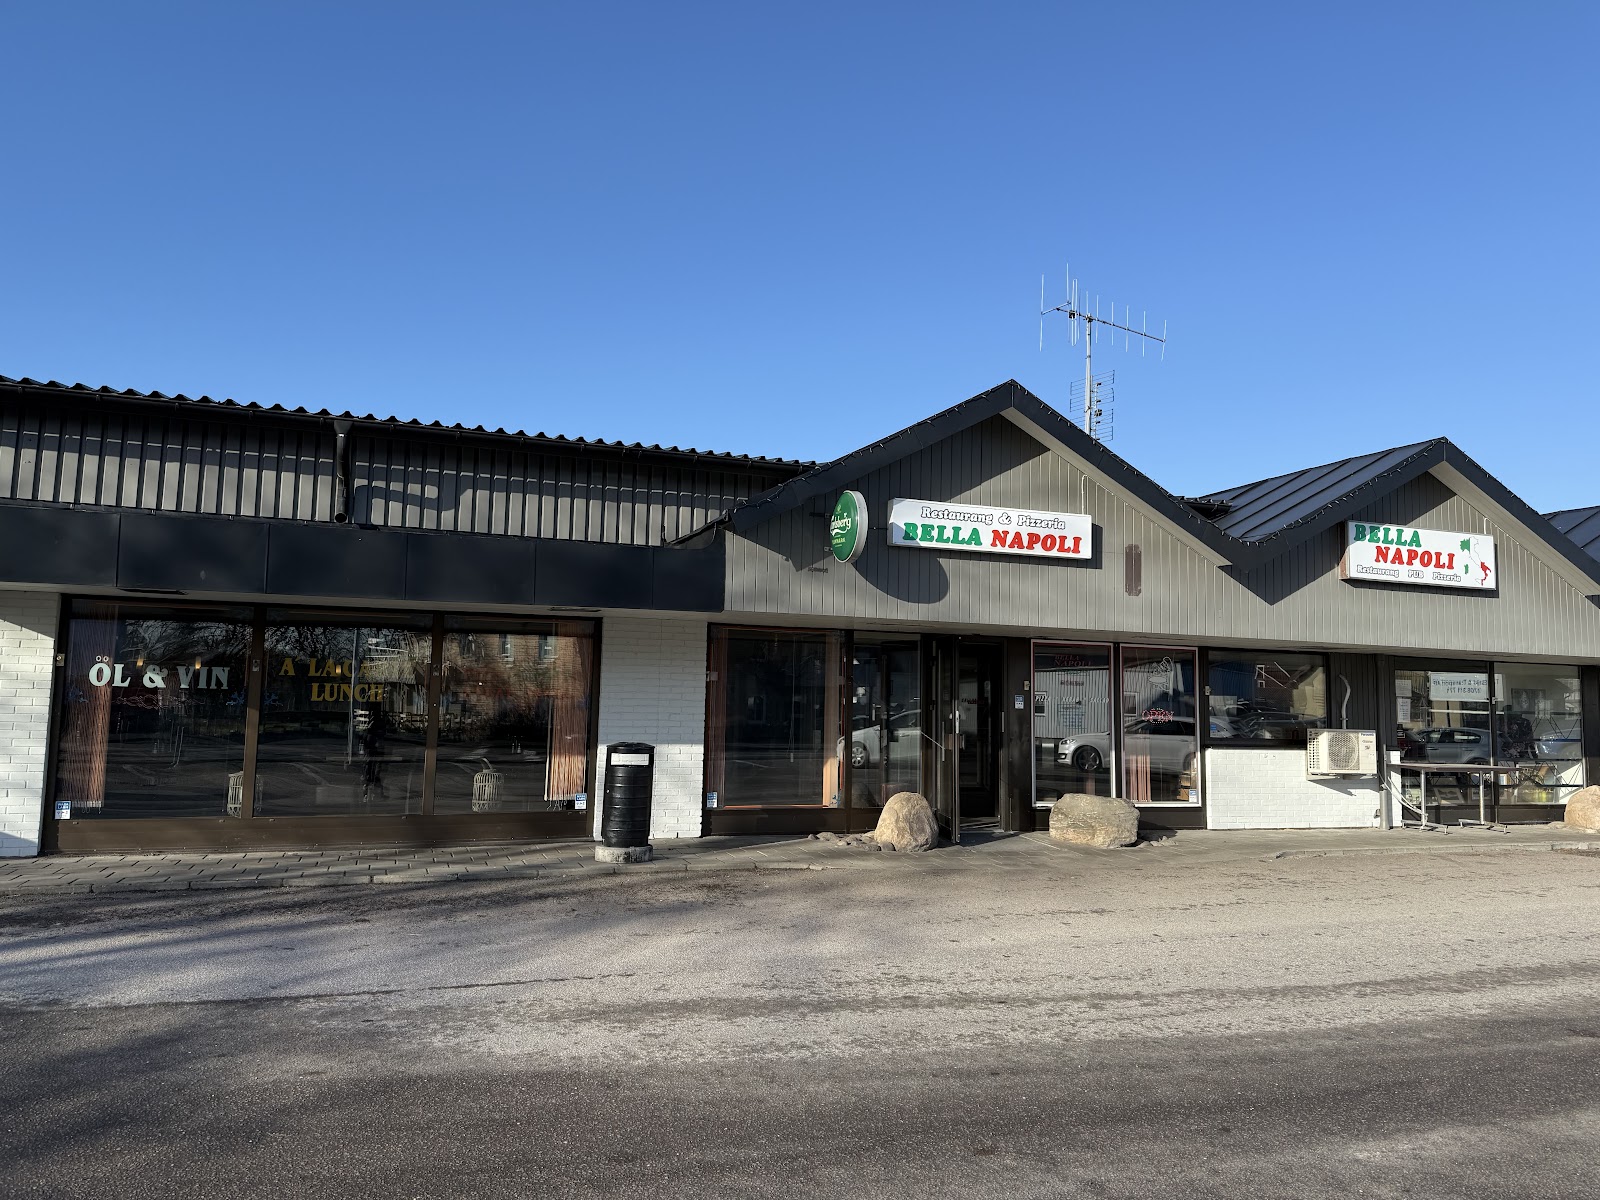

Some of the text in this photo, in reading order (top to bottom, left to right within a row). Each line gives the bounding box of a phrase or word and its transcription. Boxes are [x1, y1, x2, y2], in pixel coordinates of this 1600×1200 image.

[921, 506, 1066, 530] Restaurang & Pizzeria
[902, 522, 1082, 554] BELLA NAPOLI
[1353, 523, 1422, 548] BELLA
[1374, 545, 1456, 570] NAPOLI
[1356, 564, 1462, 583] Restaurang PUB Pizzeria
[88, 655, 231, 690] ÖL & VIN
[308, 657, 339, 677] LA
[310, 682, 385, 703] LUNCH
